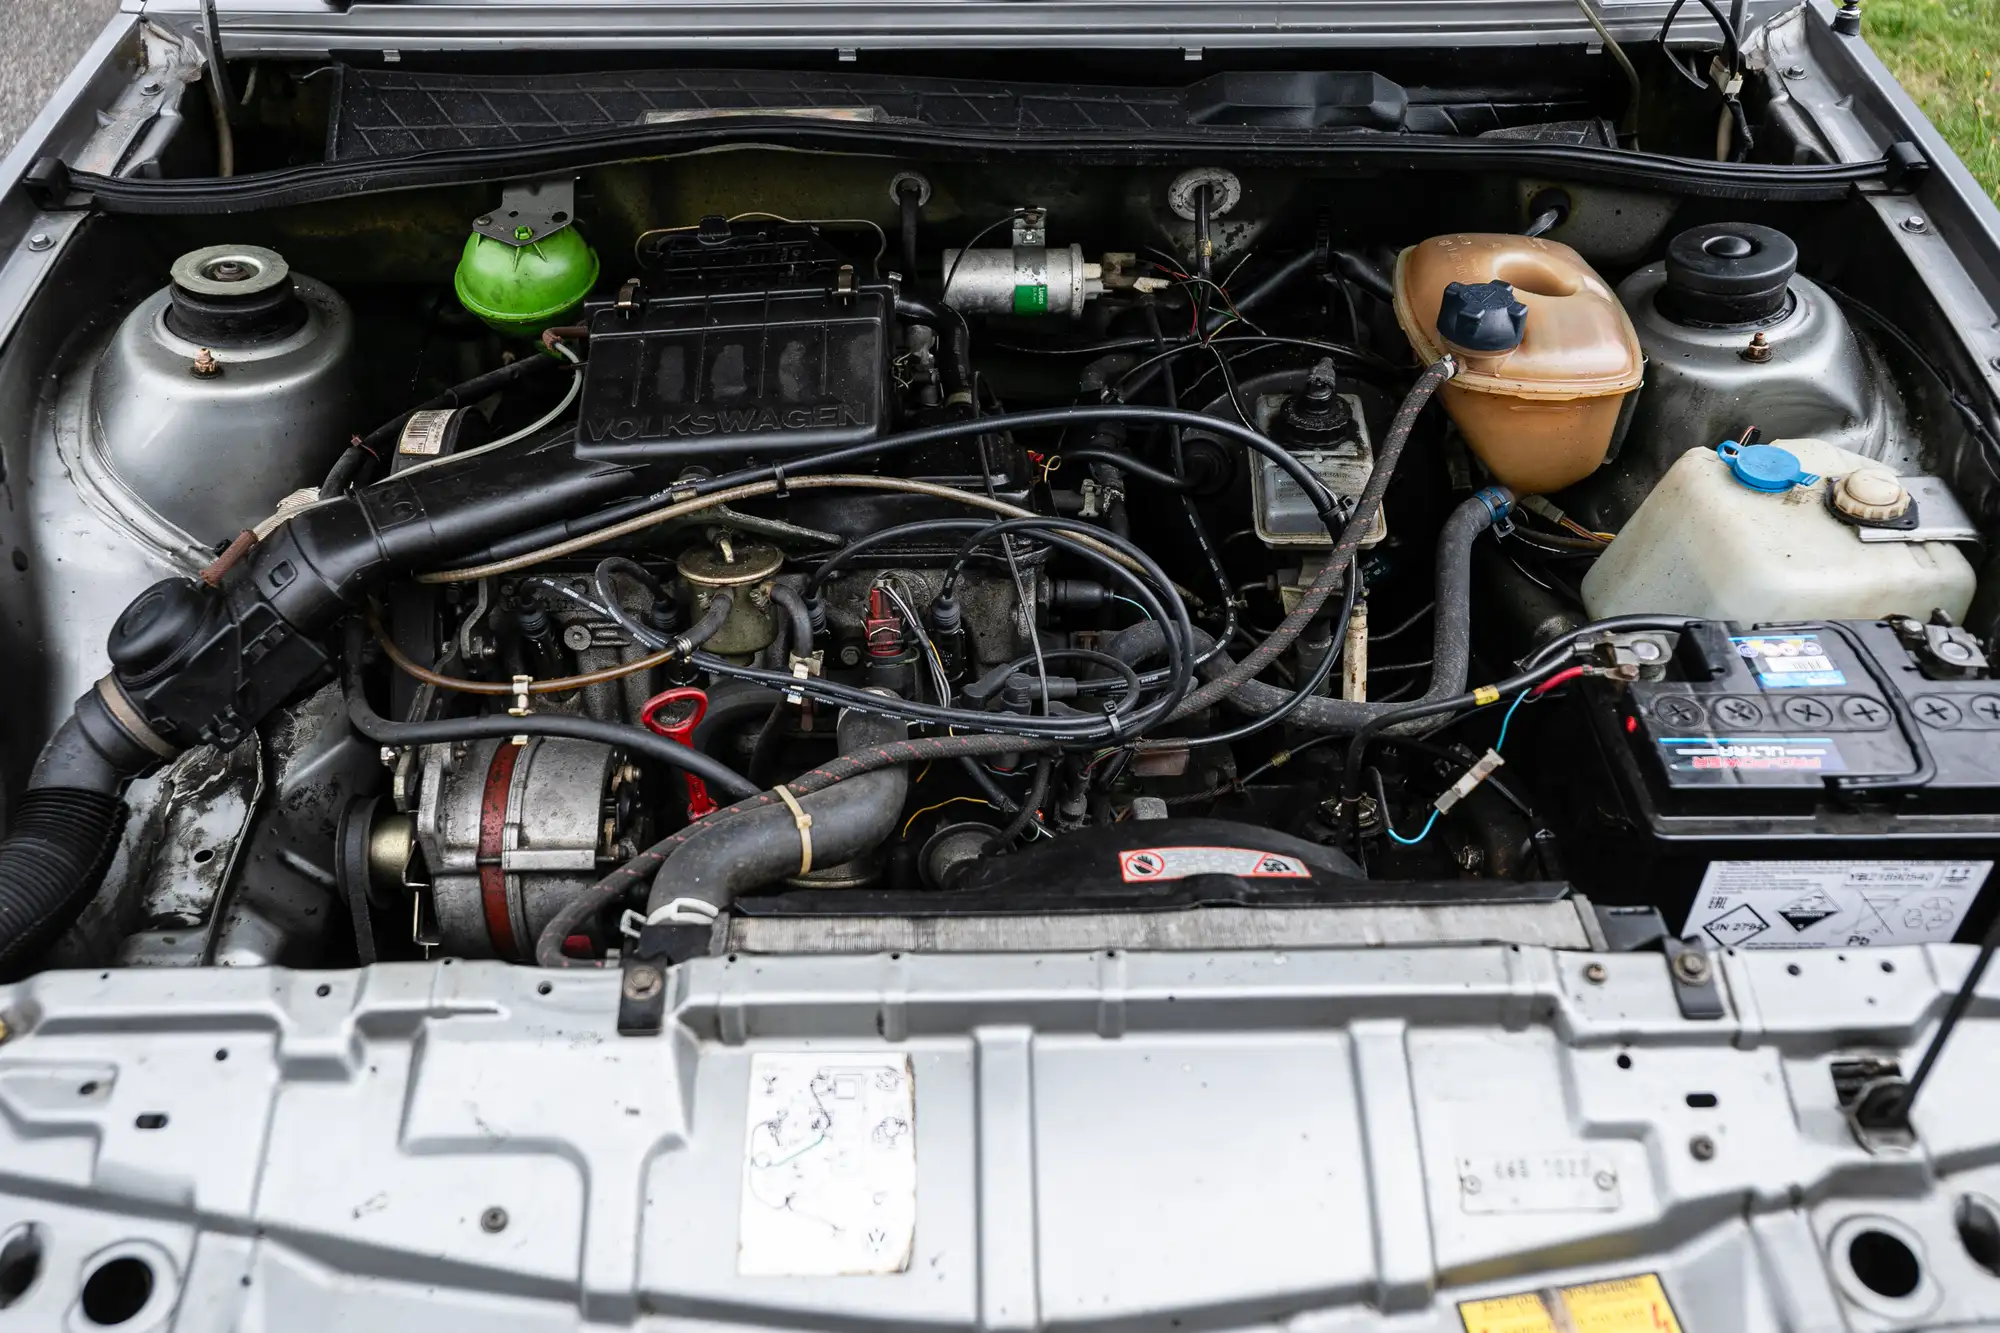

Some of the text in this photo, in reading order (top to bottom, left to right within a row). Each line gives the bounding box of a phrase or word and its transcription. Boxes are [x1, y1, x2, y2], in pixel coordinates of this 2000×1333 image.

[1038, 285, 1046, 305] Lucas
[586, 402, 868, 441] VOLKSWAGEN
[1718, 745, 1785, 757] ULTRA
[1709, 922, 1730, 932] UN
[1846, 935, 1871, 946] Pb
